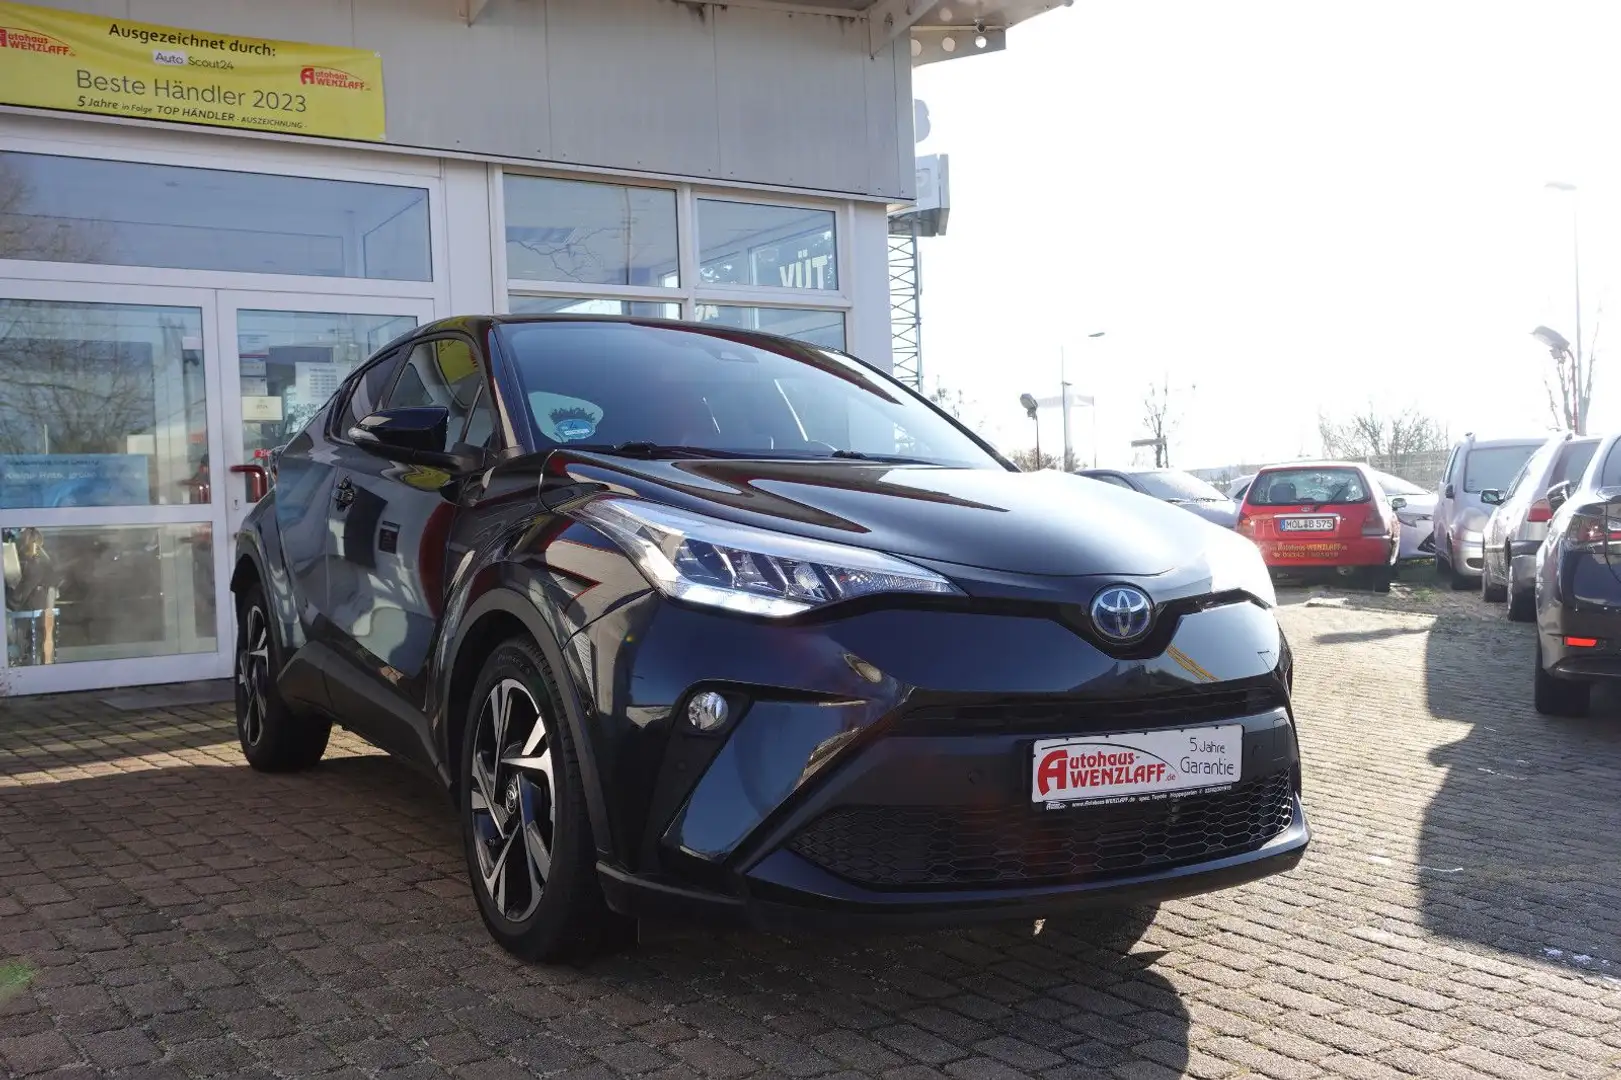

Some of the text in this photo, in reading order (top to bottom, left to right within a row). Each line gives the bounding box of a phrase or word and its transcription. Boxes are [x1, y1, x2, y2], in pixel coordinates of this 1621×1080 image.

[109, 24, 276, 57] Ausgezeichnet durch:
[155, 52, 234, 70] Auto Scout24
[77, 69, 307, 113] Beste Händler 2023
[77, 95, 86, 107] 5
[88, 97, 119, 110] Jahre
[122, 103, 130, 111] in
[131, 104, 153, 115] Folge
[157, 105, 179, 115] TOP
[182, 107, 235, 122] HÄNDLER
[1286, 519, 1333, 529] MOL B 575
[1189, 737, 1225, 754] 5 Jahre
[1180, 755, 1235, 776] Garantie
